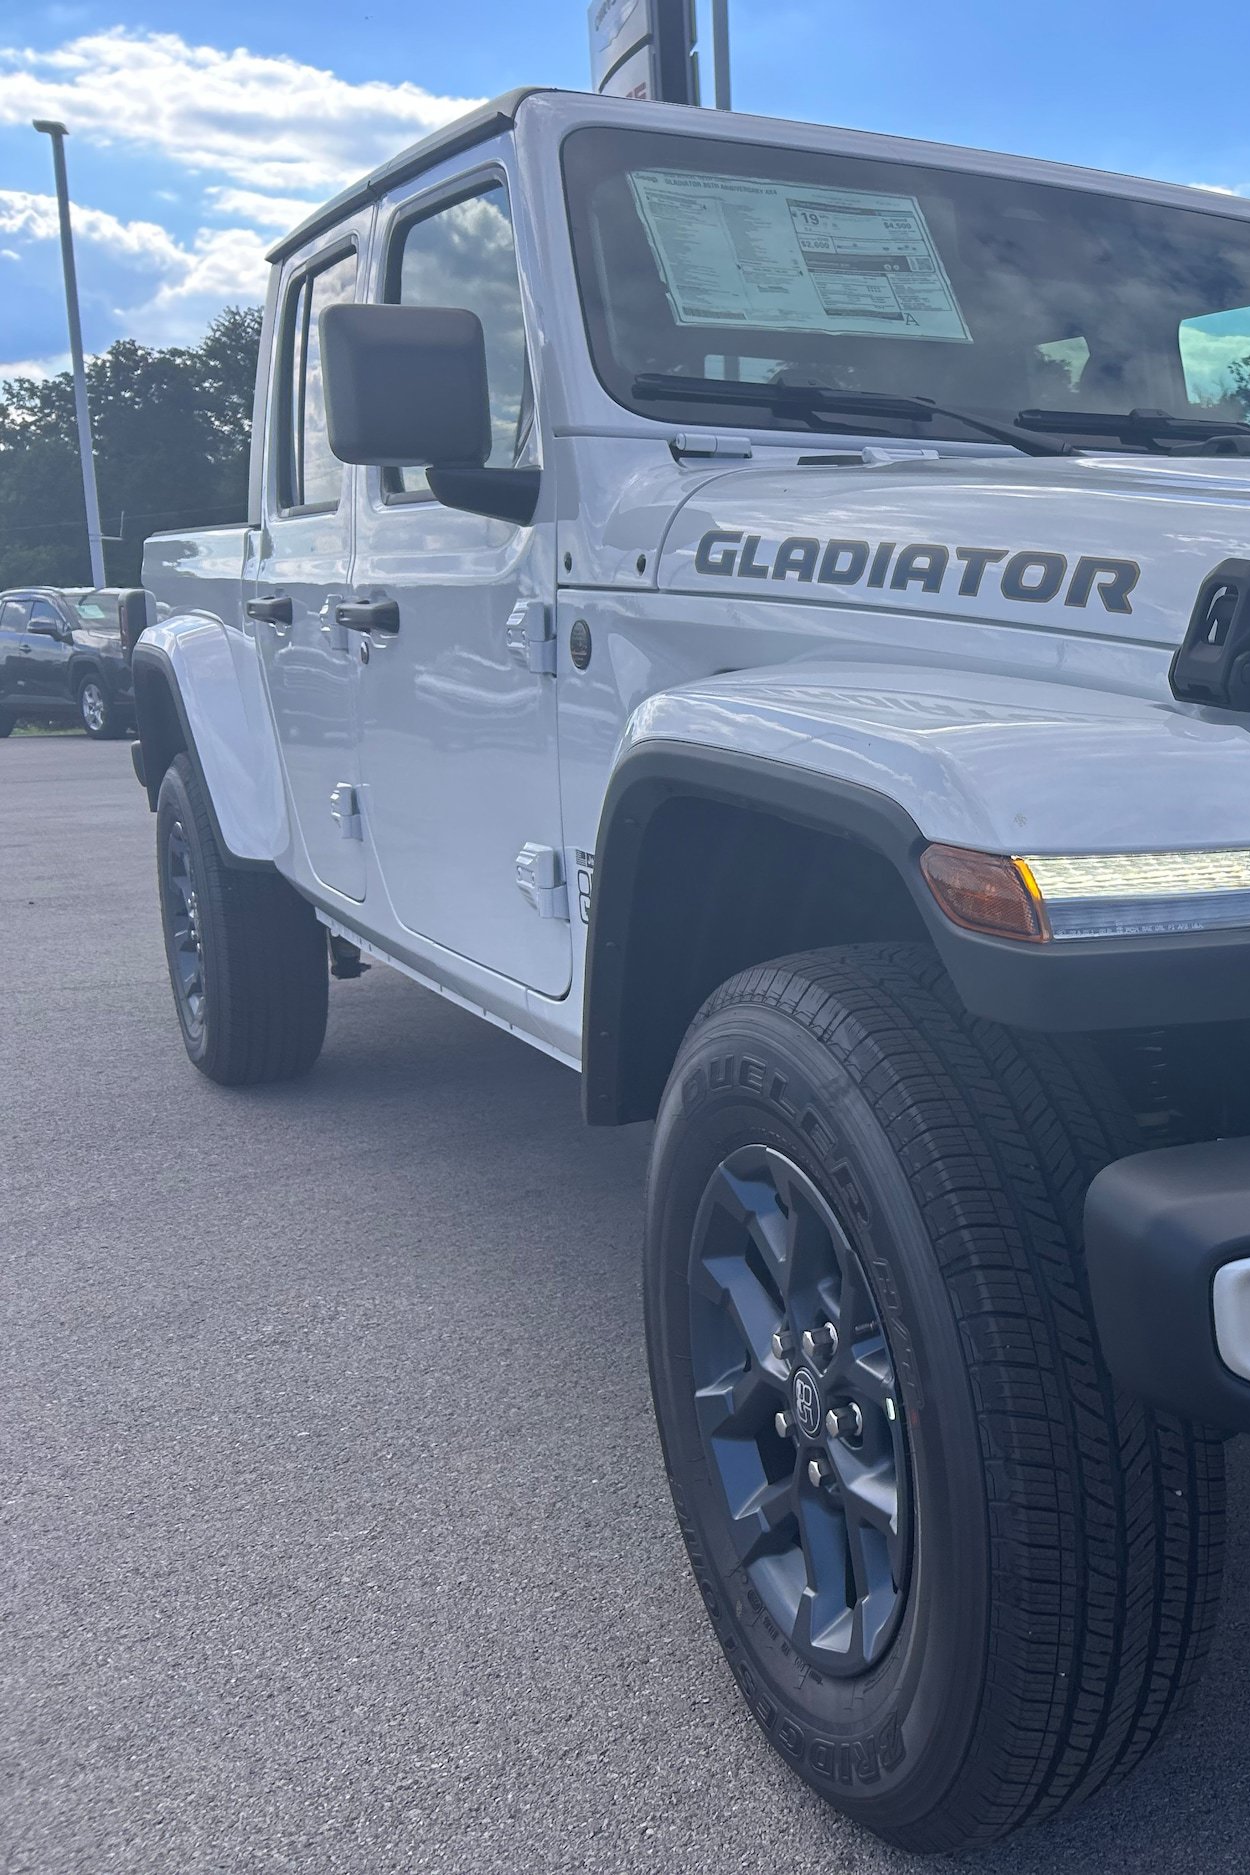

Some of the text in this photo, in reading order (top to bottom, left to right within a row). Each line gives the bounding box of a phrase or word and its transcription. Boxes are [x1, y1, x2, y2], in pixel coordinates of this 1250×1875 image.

[801, 212, 820, 226] 19
[694, 530, 1141, 615] GLADIATOR
[681, 1052, 873, 1232] DUELER
